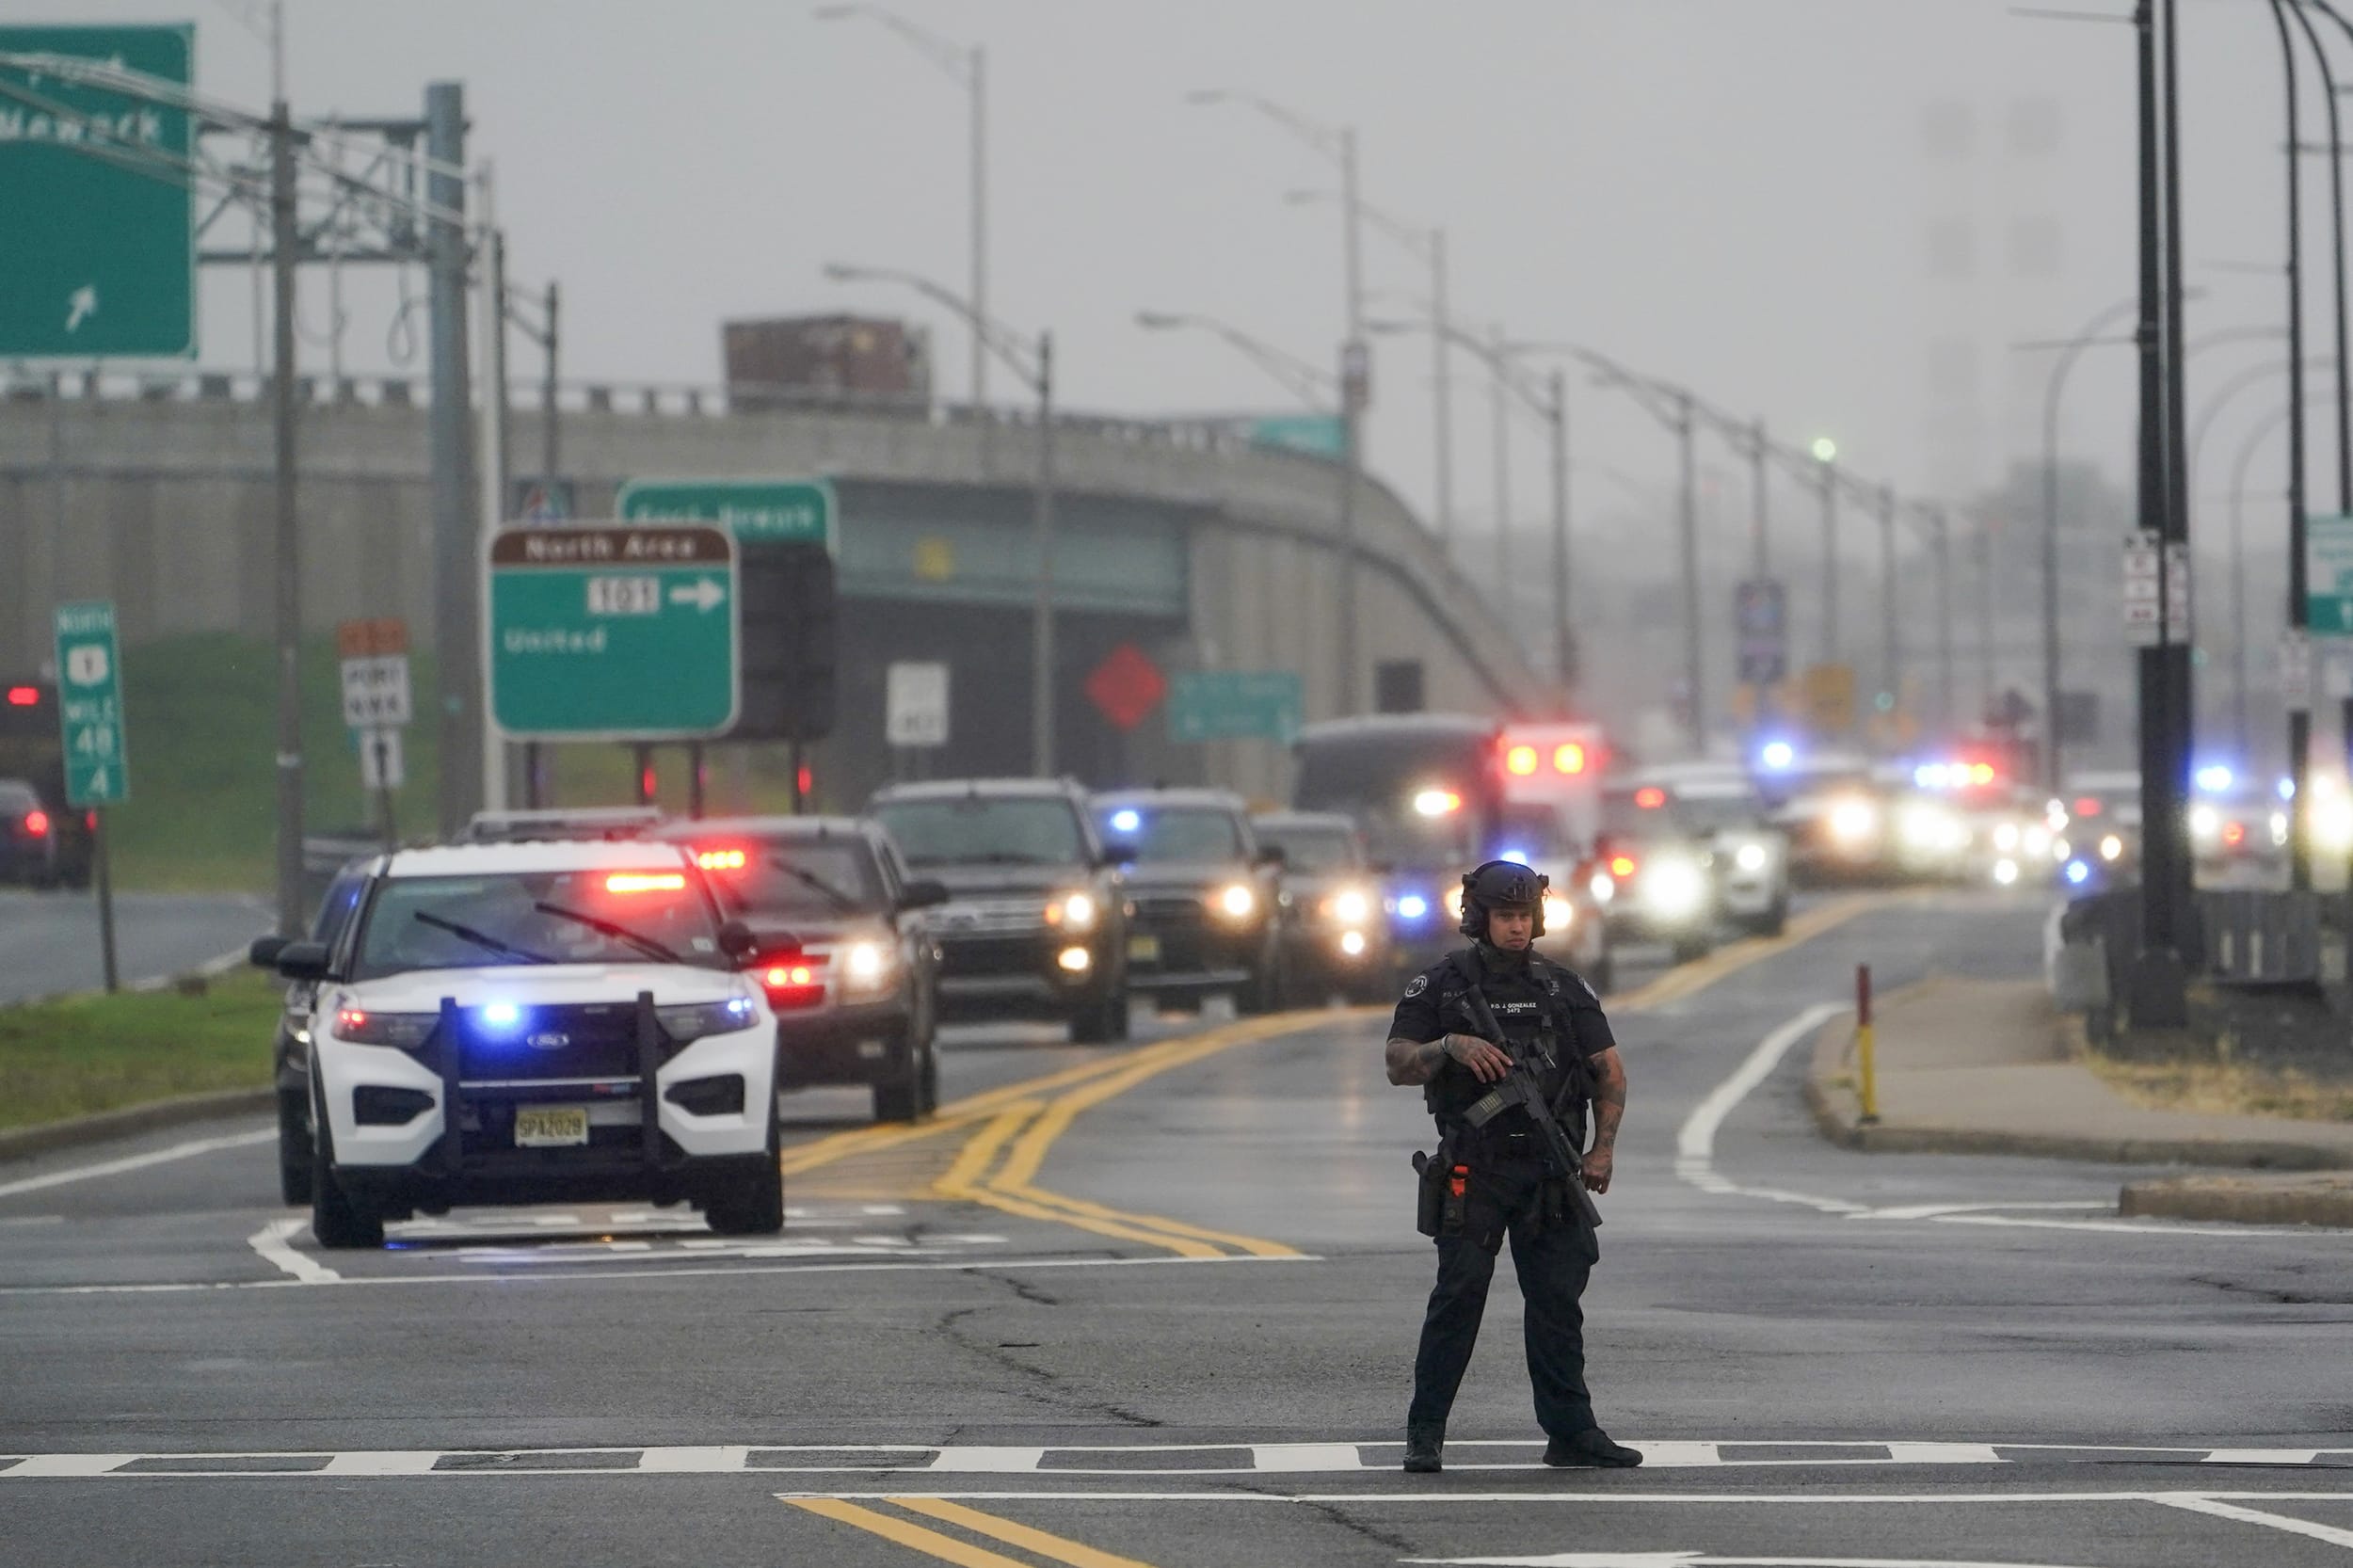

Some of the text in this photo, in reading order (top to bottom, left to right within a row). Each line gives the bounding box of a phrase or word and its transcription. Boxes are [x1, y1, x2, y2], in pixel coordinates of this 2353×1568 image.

[525, 534, 696, 560] North Area
[600, 581, 650, 611] 101
[504, 628, 606, 653] United
